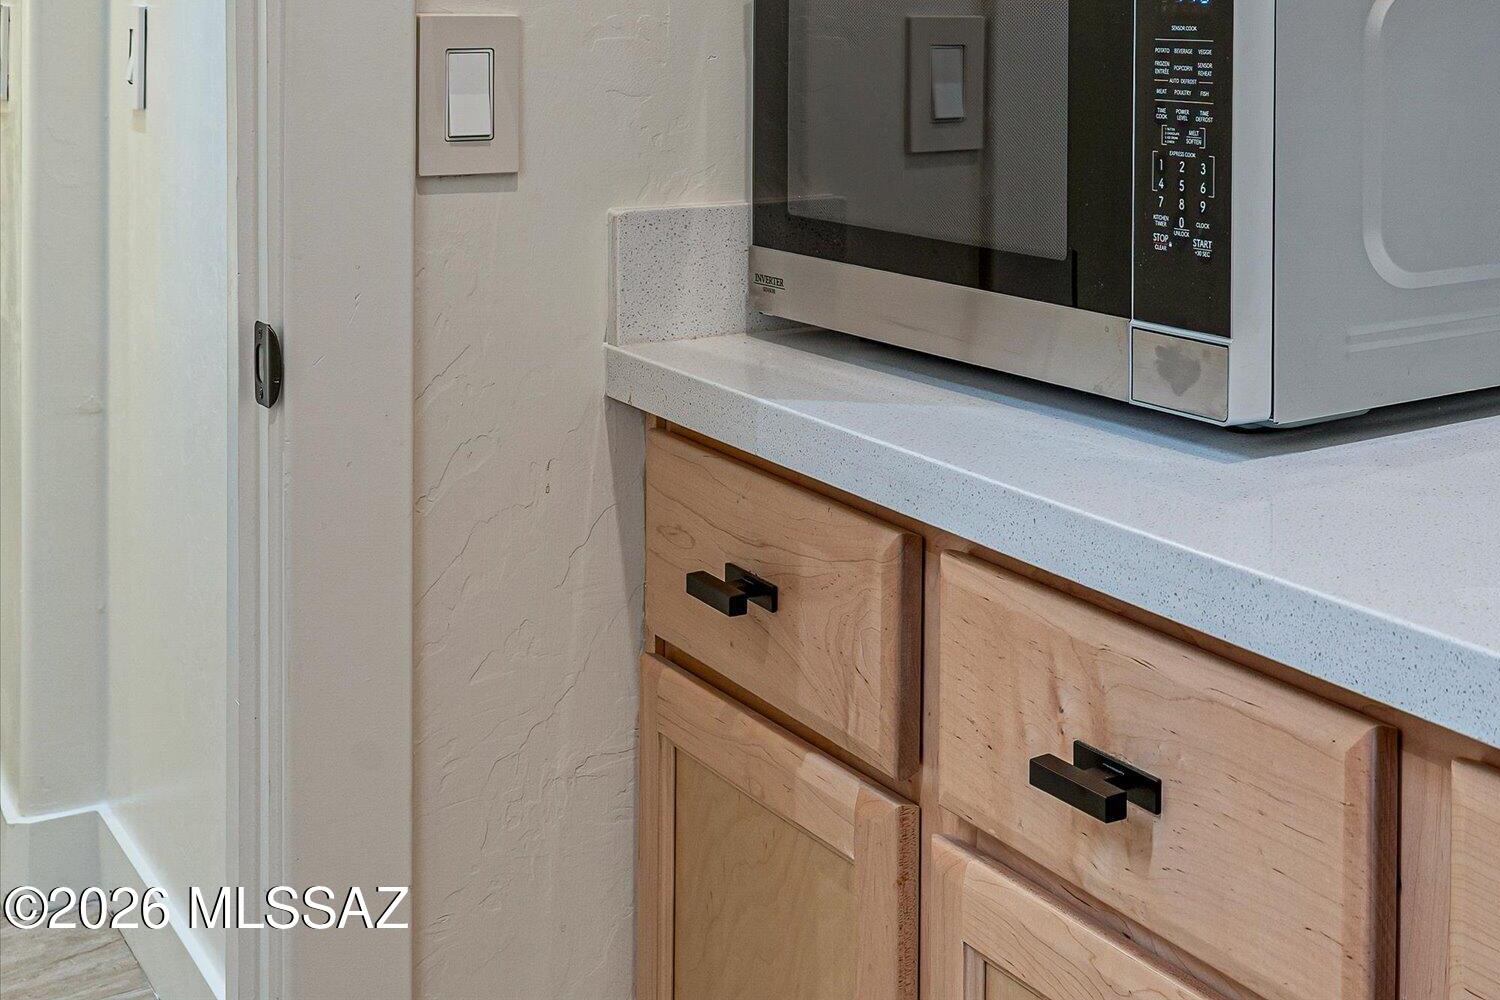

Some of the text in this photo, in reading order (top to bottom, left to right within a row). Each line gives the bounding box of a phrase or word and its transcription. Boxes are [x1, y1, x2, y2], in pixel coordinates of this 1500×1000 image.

[1185, 138, 1202, 146] SOFTEN
[1159, 159, 1163, 171] 1
[1179, 161, 1185, 173] 2
[1200, 163, 1206, 175] 3
[1158, 178, 1164, 189] 4
[1179, 180, 1185, 192] 5
[1200, 183, 1206, 194] 6
[1158, 196, 1164, 207] 7
[1178, 198, 1185, 211] 8
[1200, 201, 1206, 213] 9
[1153, 214, 1169, 222] KITCHEN
[1178, 217, 1185, 228] 0
[1153, 233, 1169, 242] STOP
[1173, 230, 1190, 238] UNLOCK
[1192, 239, 1213, 249] START
[754, 273, 784, 287] INVERTER
